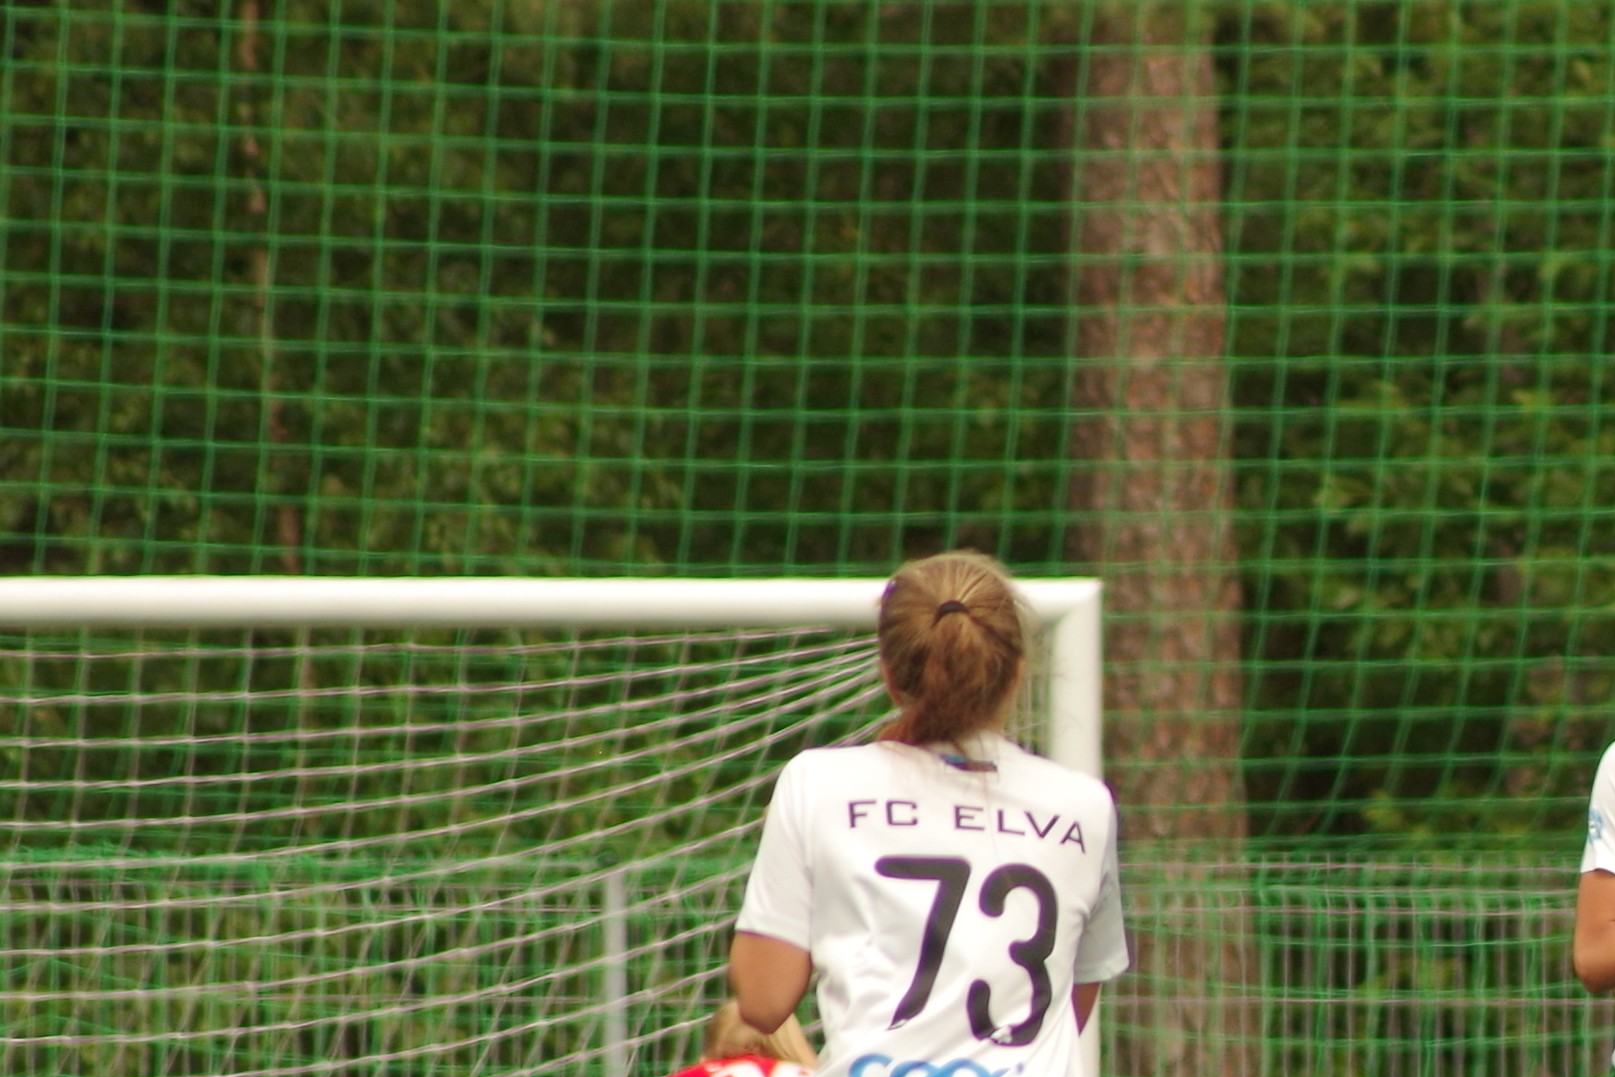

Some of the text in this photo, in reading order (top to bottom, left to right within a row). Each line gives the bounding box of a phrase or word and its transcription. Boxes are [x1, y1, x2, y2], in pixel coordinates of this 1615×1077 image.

[848, 800, 1086, 853] FC ELVA
[875, 855, 1059, 1047] 73
